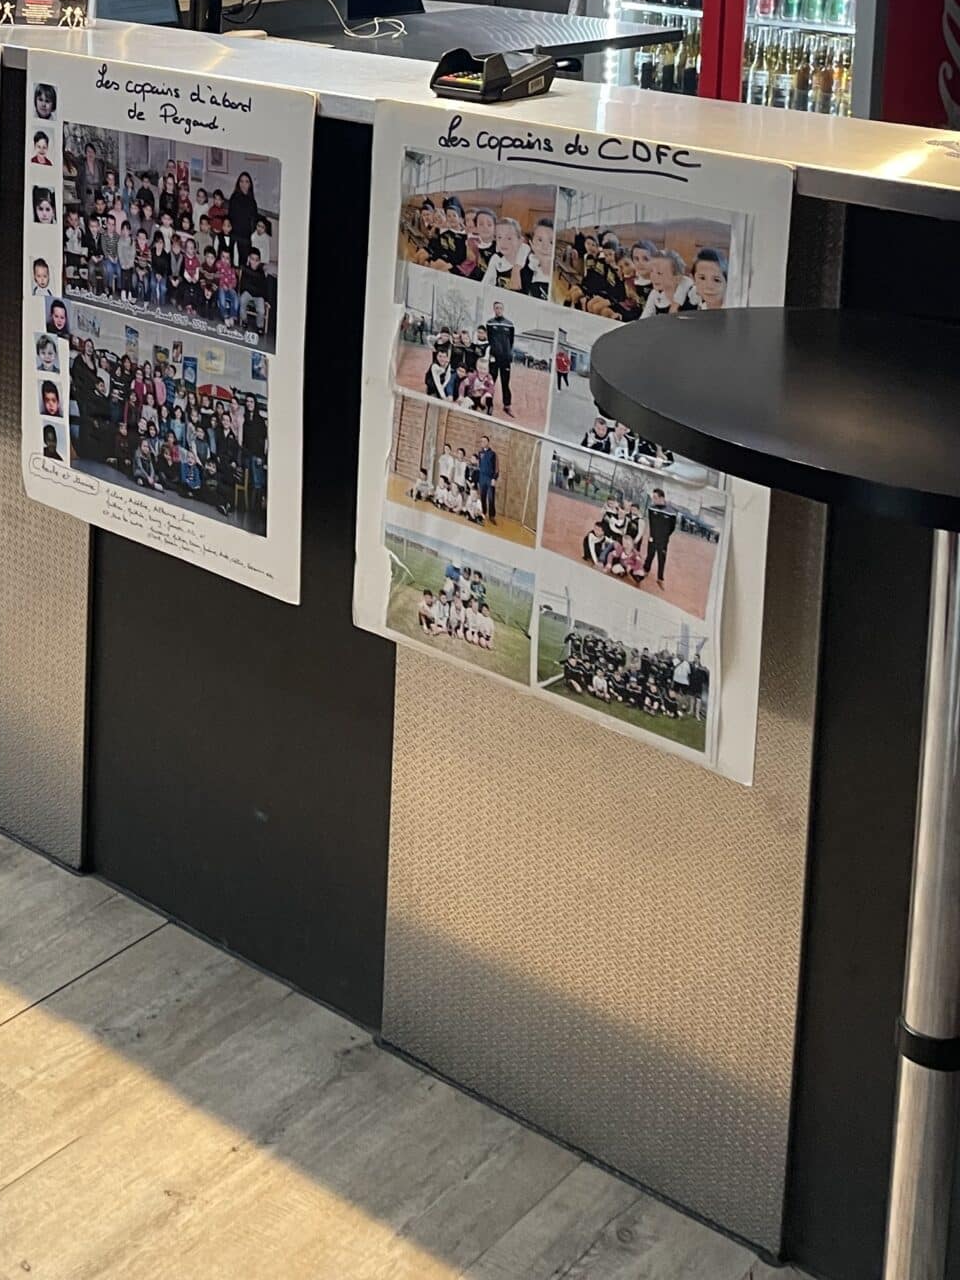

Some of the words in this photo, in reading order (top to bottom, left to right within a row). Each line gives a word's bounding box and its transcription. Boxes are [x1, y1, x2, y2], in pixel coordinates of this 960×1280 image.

[96, 63, 120, 91] Les
[128, 102, 146, 121] de
[438, 115, 470, 148] Les
[564, 134, 589, 156] du
[598, 137, 701, 168] CDFC
